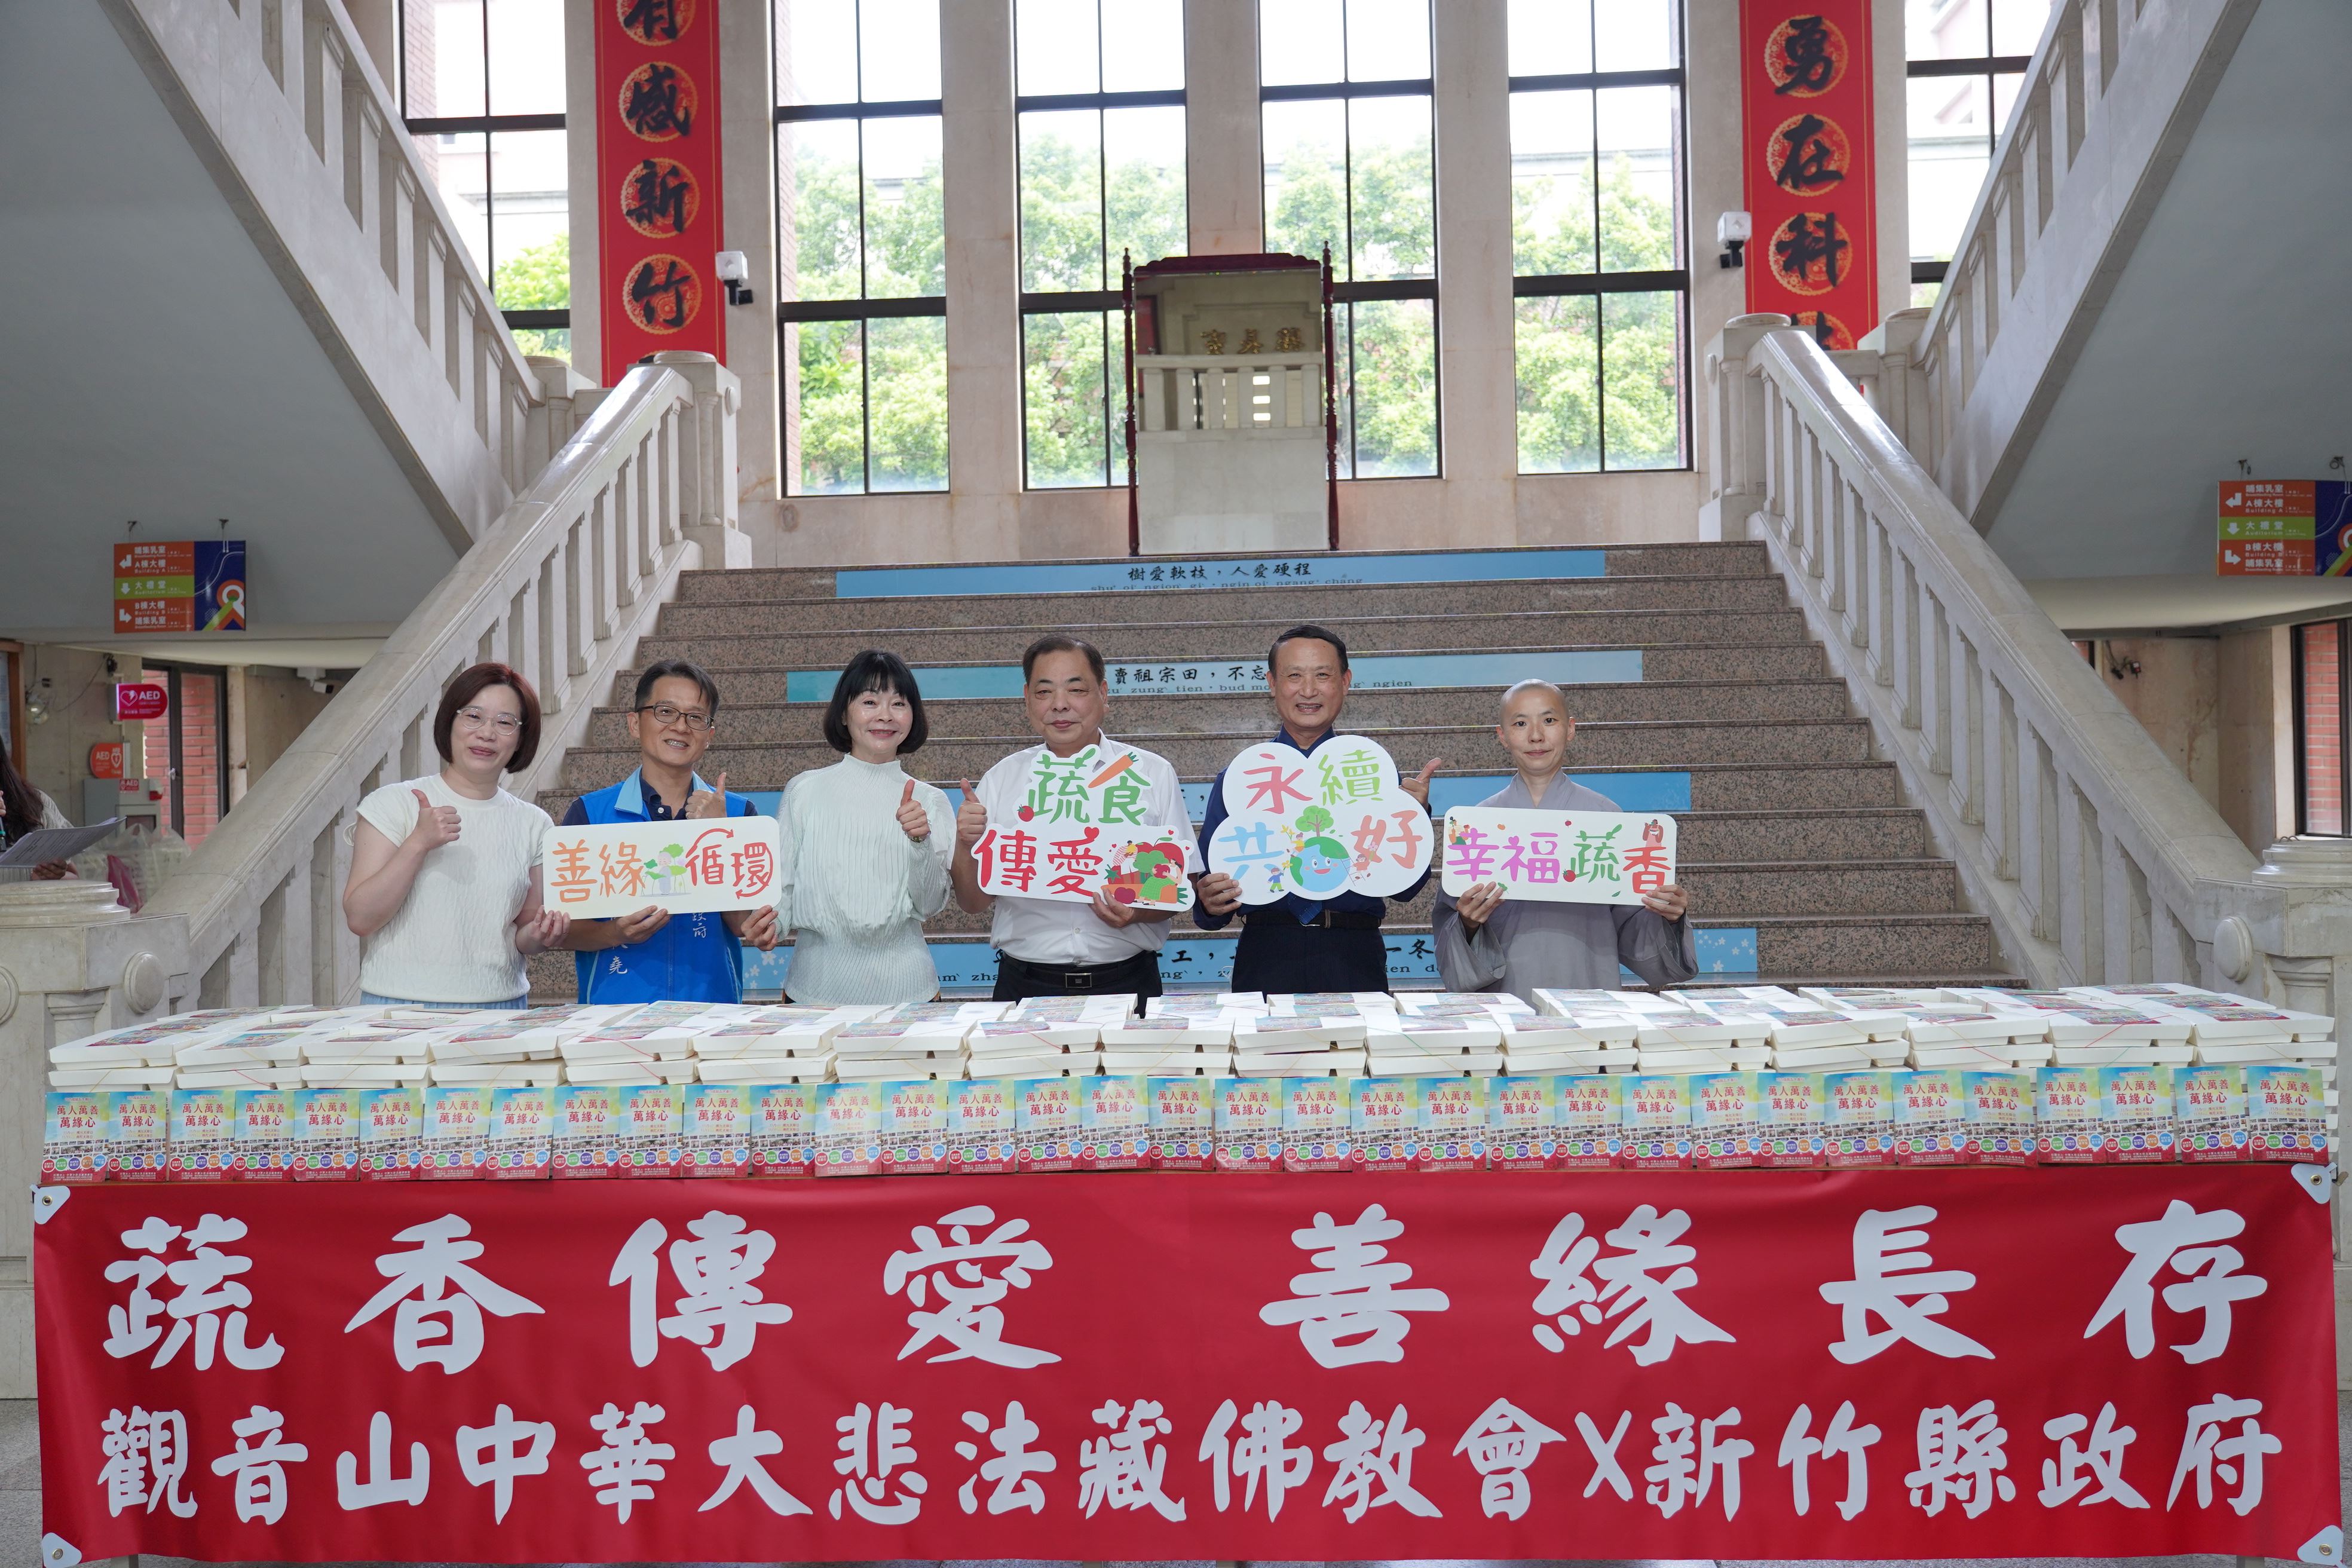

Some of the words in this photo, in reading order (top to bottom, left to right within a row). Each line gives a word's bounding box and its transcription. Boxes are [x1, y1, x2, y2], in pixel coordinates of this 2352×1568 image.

[623, 0, 691, 363] 有感新竹
[138, 690, 161, 700] AED
[96, 751, 110, 760] AED
[1242, 749, 1382, 814] 永續
[973, 826, 1104, 898] 傳愛
[1446, 823, 1673, 895] 幸福蔬香
[1835, 1085, 1879, 1096] 萬人萬善
[1904, 1083, 1949, 1094] 萬人萬善
[1975, 1085, 2019, 1097] 萬人萬善
[2046, 1082, 2087, 1092] 萬人萬善
[2112, 1080, 2156, 1091] 萬人萬善
[2186, 1080, 2228, 1091] 萬人萬善
[2261, 1080, 2309, 1092] 萬人萬善
[1027, 1090, 1069, 1102] 萬人萬善
[1092, 1089, 1134, 1100] 萬人萬善
[1158, 1091, 1199, 1101] 萬人萬善
[1226, 1092, 1269, 1102] 萬人萬善
[1294, 1091, 1337, 1102] 萬人萬善
[1428, 1091, 1471, 1101] 萬人萬善
[1500, 1090, 1542, 1101] 萬人萬善
[1566, 1088, 1609, 1098] 萬人萬善
[1633, 1089, 1676, 1100] 萬人萬善
[1702, 1086, 1745, 1098] 萬人萬善
[1768, 1086, 1811, 1097] 萬人萬善
[630, 1098, 670, 1108] 萬人萬善
[696, 1098, 738, 1107] 萬人萬善
[762, 1098, 804, 1108] 萬人萬善
[828, 1097, 868, 1106] 萬人萬善
[893, 1094, 934, 1104] 萬人萬善
[960, 1094, 1002, 1105] 萬人萬善
[1362, 1092, 1404, 1103] 萬人萬善
[1909, 1097, 1948, 1108] 萬緣心
[2049, 1094, 2085, 1106] 萬緣心
[2116, 1093, 2154, 1105] 萬緣心
[2189, 1092, 2227, 1104] 萬緣心
[2265, 1092, 2307, 1105] 萬緣心
[120, 1104, 156, 1114] 萬人萬善
[183, 1104, 223, 1113] 萬人萬善
[246, 1103, 284, 1113] 萬人萬善
[305, 1102, 347, 1112] 萬人萬善
[371, 1102, 410, 1113] 萬人萬善
[437, 1100, 479, 1110] 萬人萬善
[503, 1101, 543, 1111] 萬人萬善
[566, 1099, 608, 1110] 萬人萬善
[1096, 1102, 1133, 1113] 萬緣心
[1162, 1102, 1198, 1115] 萬緣心
[1297, 1103, 1335, 1115] 萬緣心
[1431, 1102, 1469, 1116] 萬緣心
[1503, 1102, 1539, 1114] 萬緣心
[1568, 1100, 1606, 1112] 萬緣心
[1637, 1101, 1674, 1113] 萬緣心
[1706, 1099, 1742, 1112] 萬緣心
[1772, 1098, 1808, 1110] 萬緣心
[1839, 1097, 1876, 1110] 萬緣心
[1979, 1097, 2018, 1110] 萬緣心
[57, 1105, 98, 1114] 萬人萬善
[764, 1109, 801, 1121] 萬緣心
[831, 1108, 865, 1119] 萬緣心
[896, 1107, 932, 1117] 萬緣心
[963, 1106, 1000, 1118] 萬緣心
[1030, 1103, 1068, 1116] 萬緣心
[1230, 1104, 1267, 1116] 萬緣心
[1365, 1104, 1403, 1116] 萬緣心
[185, 1114, 221, 1126] 萬緣心
[248, 1114, 281, 1126] 萬緣心
[308, 1114, 345, 1126] 萬緣心
[373, 1114, 408, 1126] 萬緣心
[439, 1112, 476, 1124] 萬緣心
[505, 1113, 541, 1125] 萬緣心
[568, 1111, 605, 1123] 萬緣心
[633, 1110, 668, 1122] 萬緣心
[697, 1110, 736, 1121] 萬緣心
[59, 1116, 96, 1128] 萬緣心
[122, 1116, 154, 1127] 萬緣心
[103, 1205, 1062, 1375] 蔬香傳愛
[1258, 1199, 2268, 1369] 善緣長存
